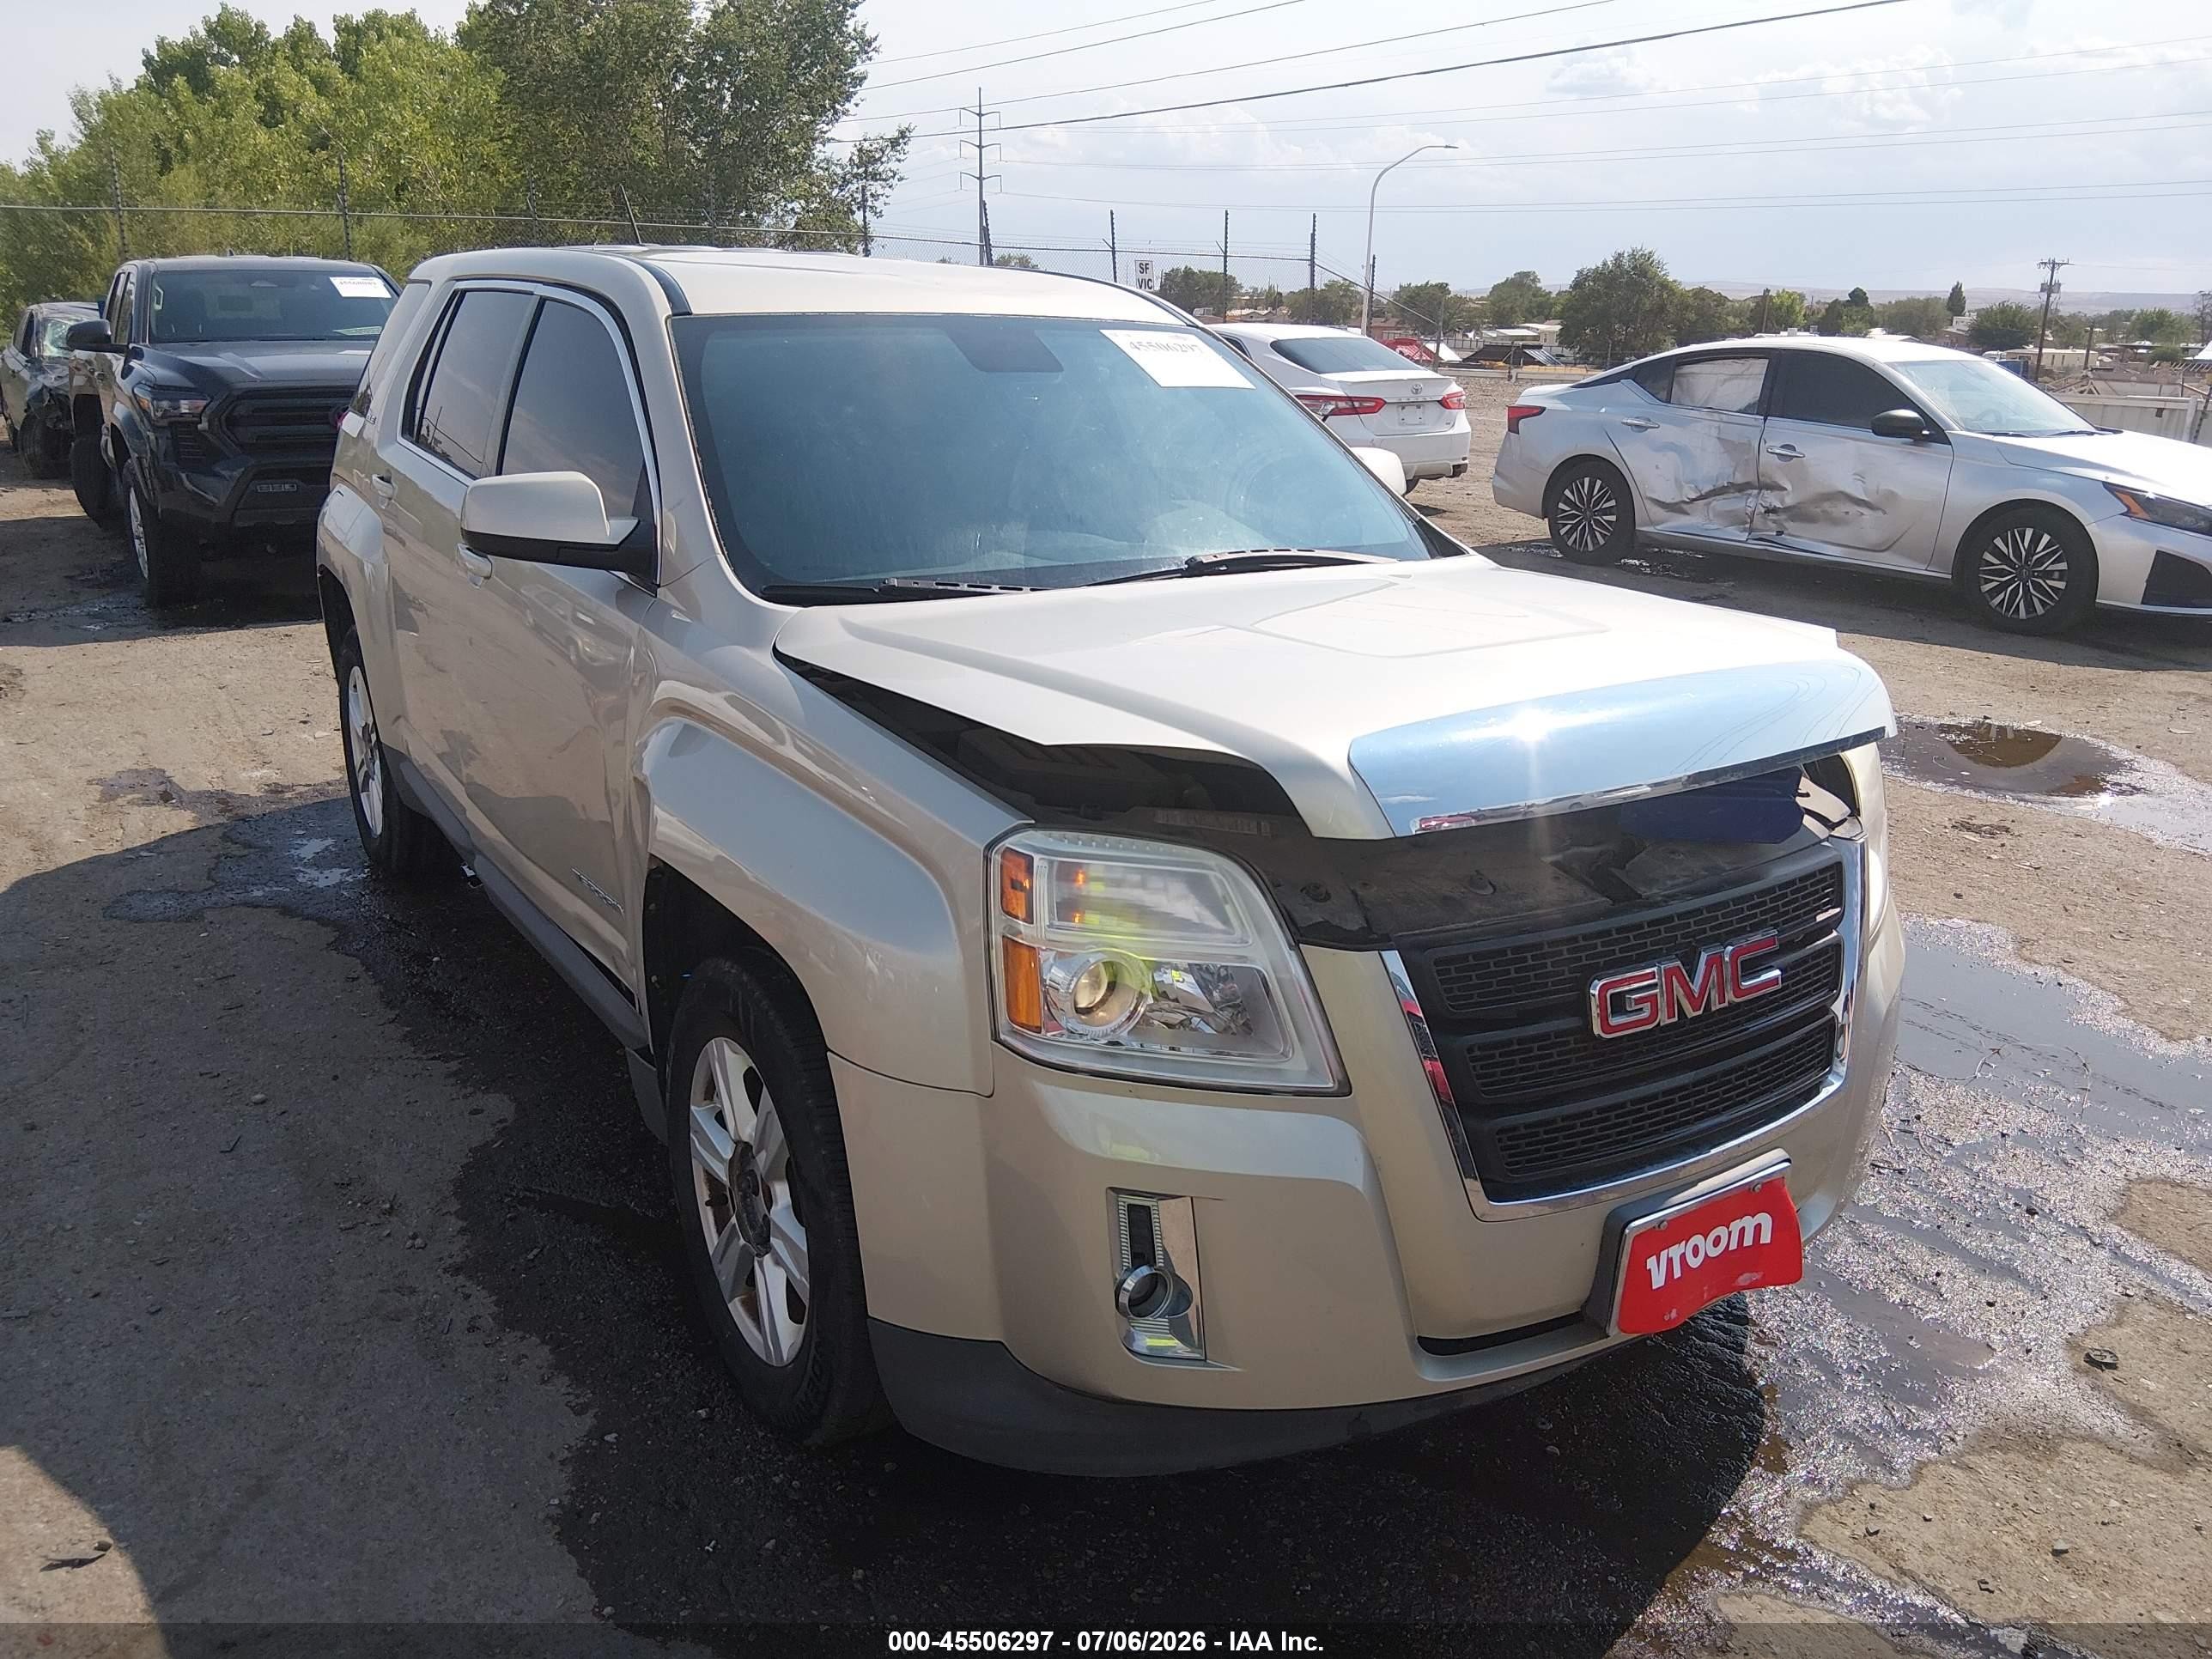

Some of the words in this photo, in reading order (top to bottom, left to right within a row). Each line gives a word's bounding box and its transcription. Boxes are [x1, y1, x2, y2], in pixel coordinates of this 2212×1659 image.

[1138, 278, 1152, 289] VIC
[1139, 262, 1149, 274] SF
[1590, 927, 1782, 1038] GMC
[1646, 1212, 1772, 1290] vroom
